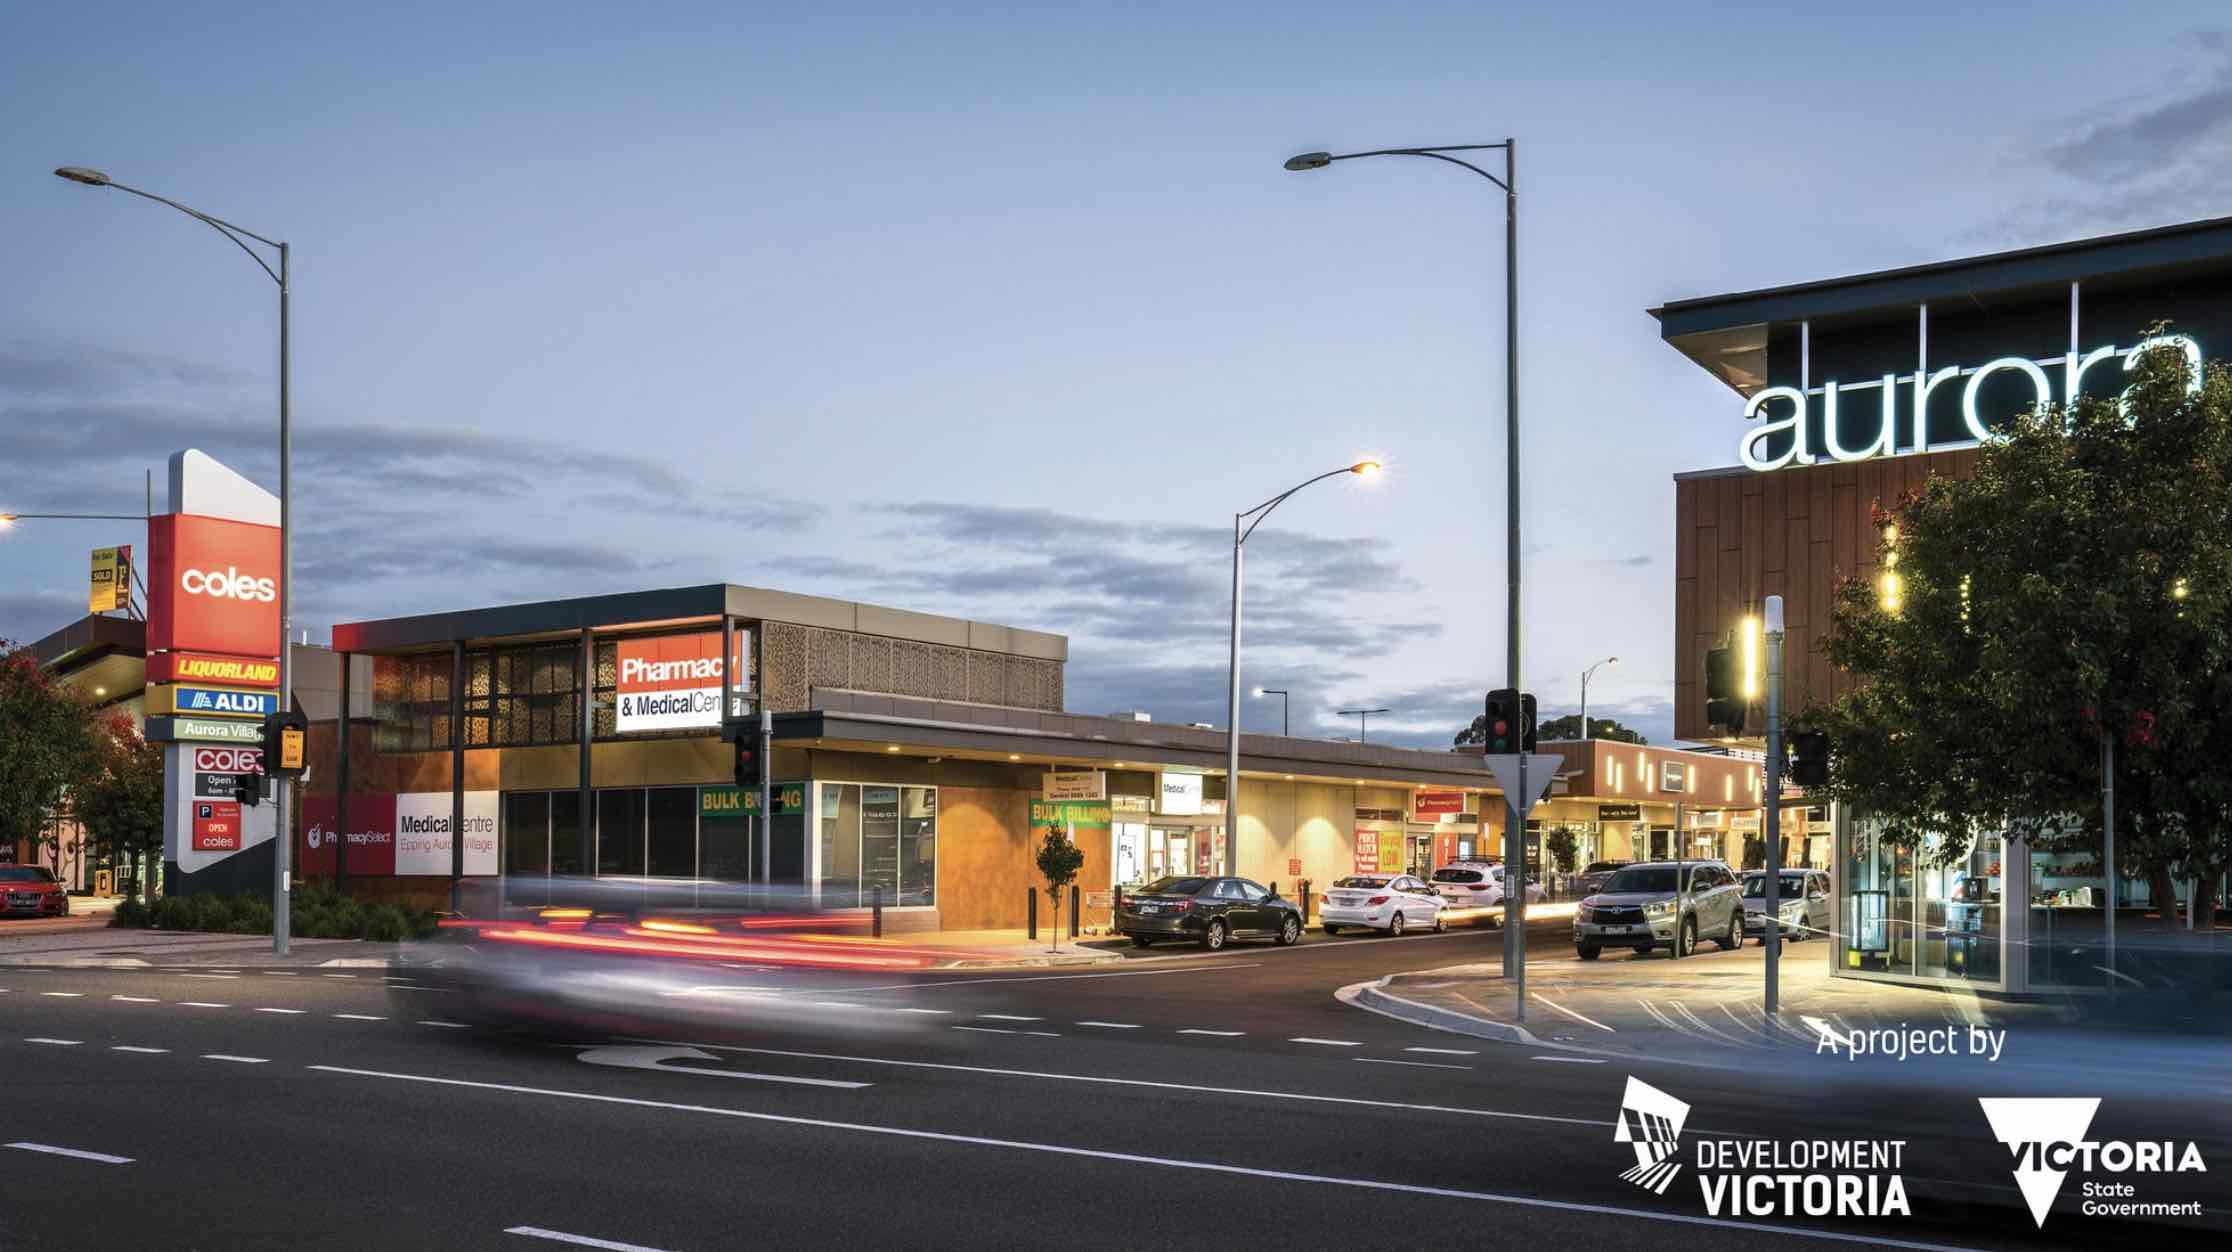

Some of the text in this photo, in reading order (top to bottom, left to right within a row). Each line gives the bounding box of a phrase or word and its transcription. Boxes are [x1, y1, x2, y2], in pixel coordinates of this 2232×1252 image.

[182, 566, 276, 602] coles
[178, 660, 277, 680] LIQUORLAND
[215, 694, 264, 712] ALDI
[622, 691, 738, 716] & MedicalCen
[184, 722, 260, 738] Aurora Villa
[208, 775, 231, 785] Open
[703, 791, 800, 810] BULK BING
[1034, 805, 1061, 821] BULK
[209, 824, 228, 833] OPEN
[401, 816, 494, 833] Medicalentre
[203, 838, 233, 847] coles
[325, 831, 390, 845] PhmacySelect
[401, 839, 494, 853] Epping Aur Village
